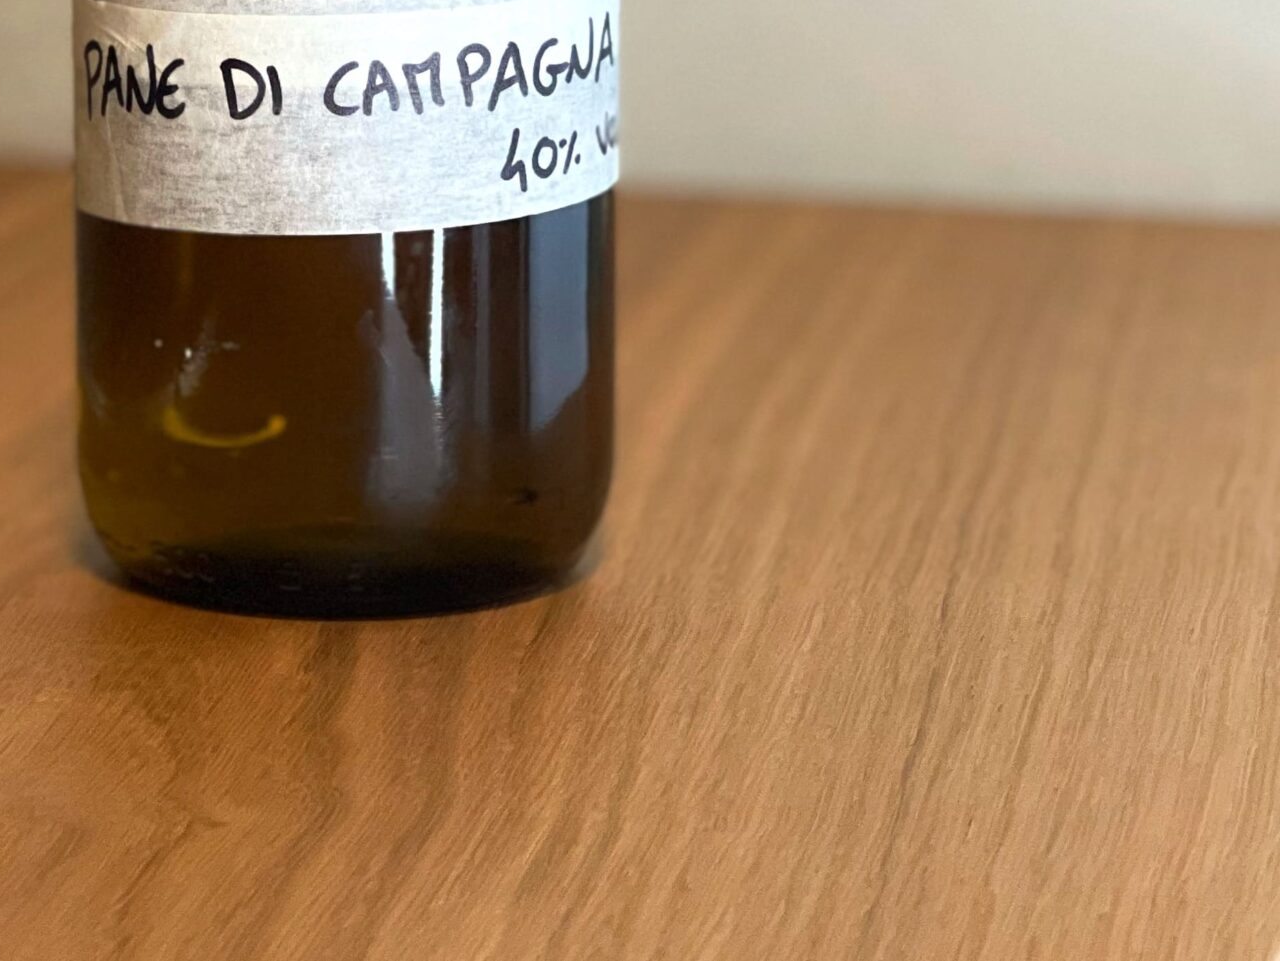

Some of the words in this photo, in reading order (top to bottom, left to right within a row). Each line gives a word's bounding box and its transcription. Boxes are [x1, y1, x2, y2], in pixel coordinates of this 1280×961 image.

[84, 40, 187, 121] PANE
[220, 57, 282, 120] DI
[323, 11, 614, 115] CAMPAGNA
[500, 127, 581, 192] 40%
